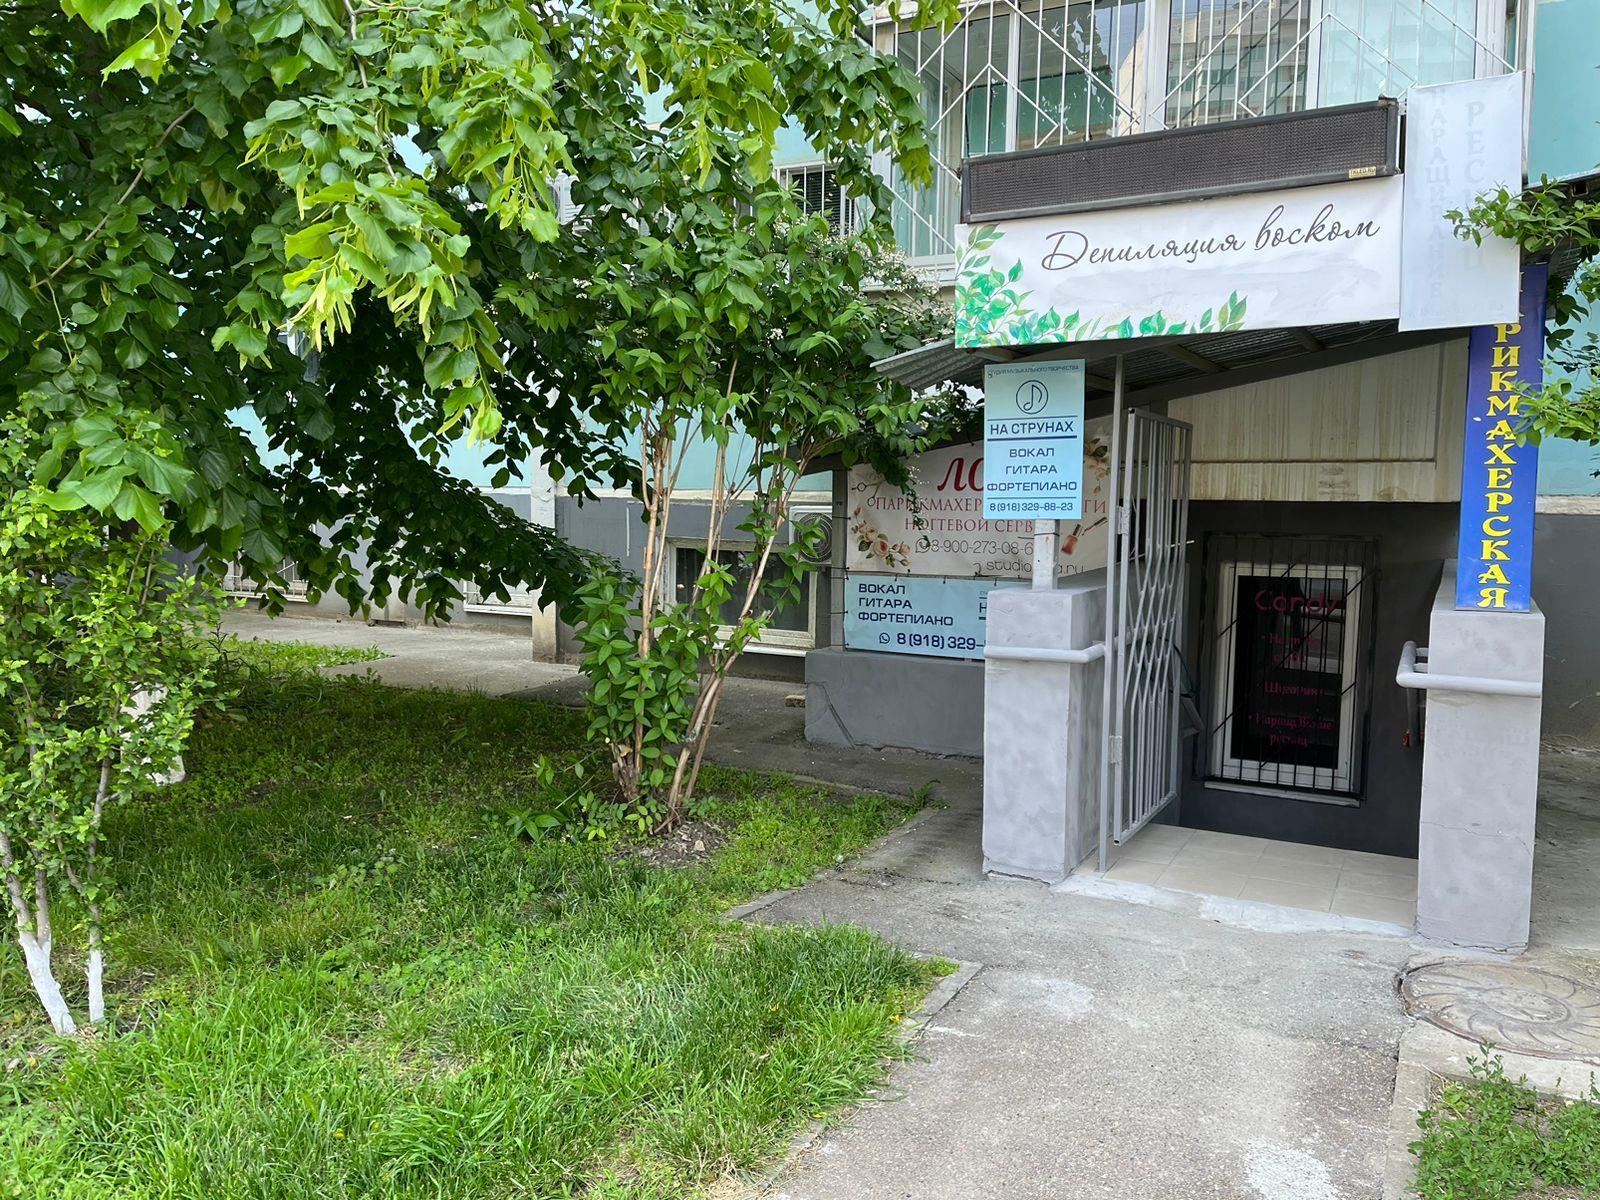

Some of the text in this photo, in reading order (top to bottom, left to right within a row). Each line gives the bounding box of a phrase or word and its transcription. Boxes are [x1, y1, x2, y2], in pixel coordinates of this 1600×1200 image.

[1041, 203, 1380, 271] Депиляция воском
[990, 421, 1074, 435] НА СТРУНАХ
[1475, 272, 1525, 609] РИКМАХЕРСКАЯ
[1009, 447, 1055, 458] ВОКАЛ
[1005, 465, 1058, 475] ГИТАРА
[987, 481, 1077, 492] ФОРТЕПИАНО
[858, 583, 906, 595] ВОКАЛ
[858, 597, 913, 610] ГИТАРА
[858, 611, 954, 626] ФОРТЕПИАНО
